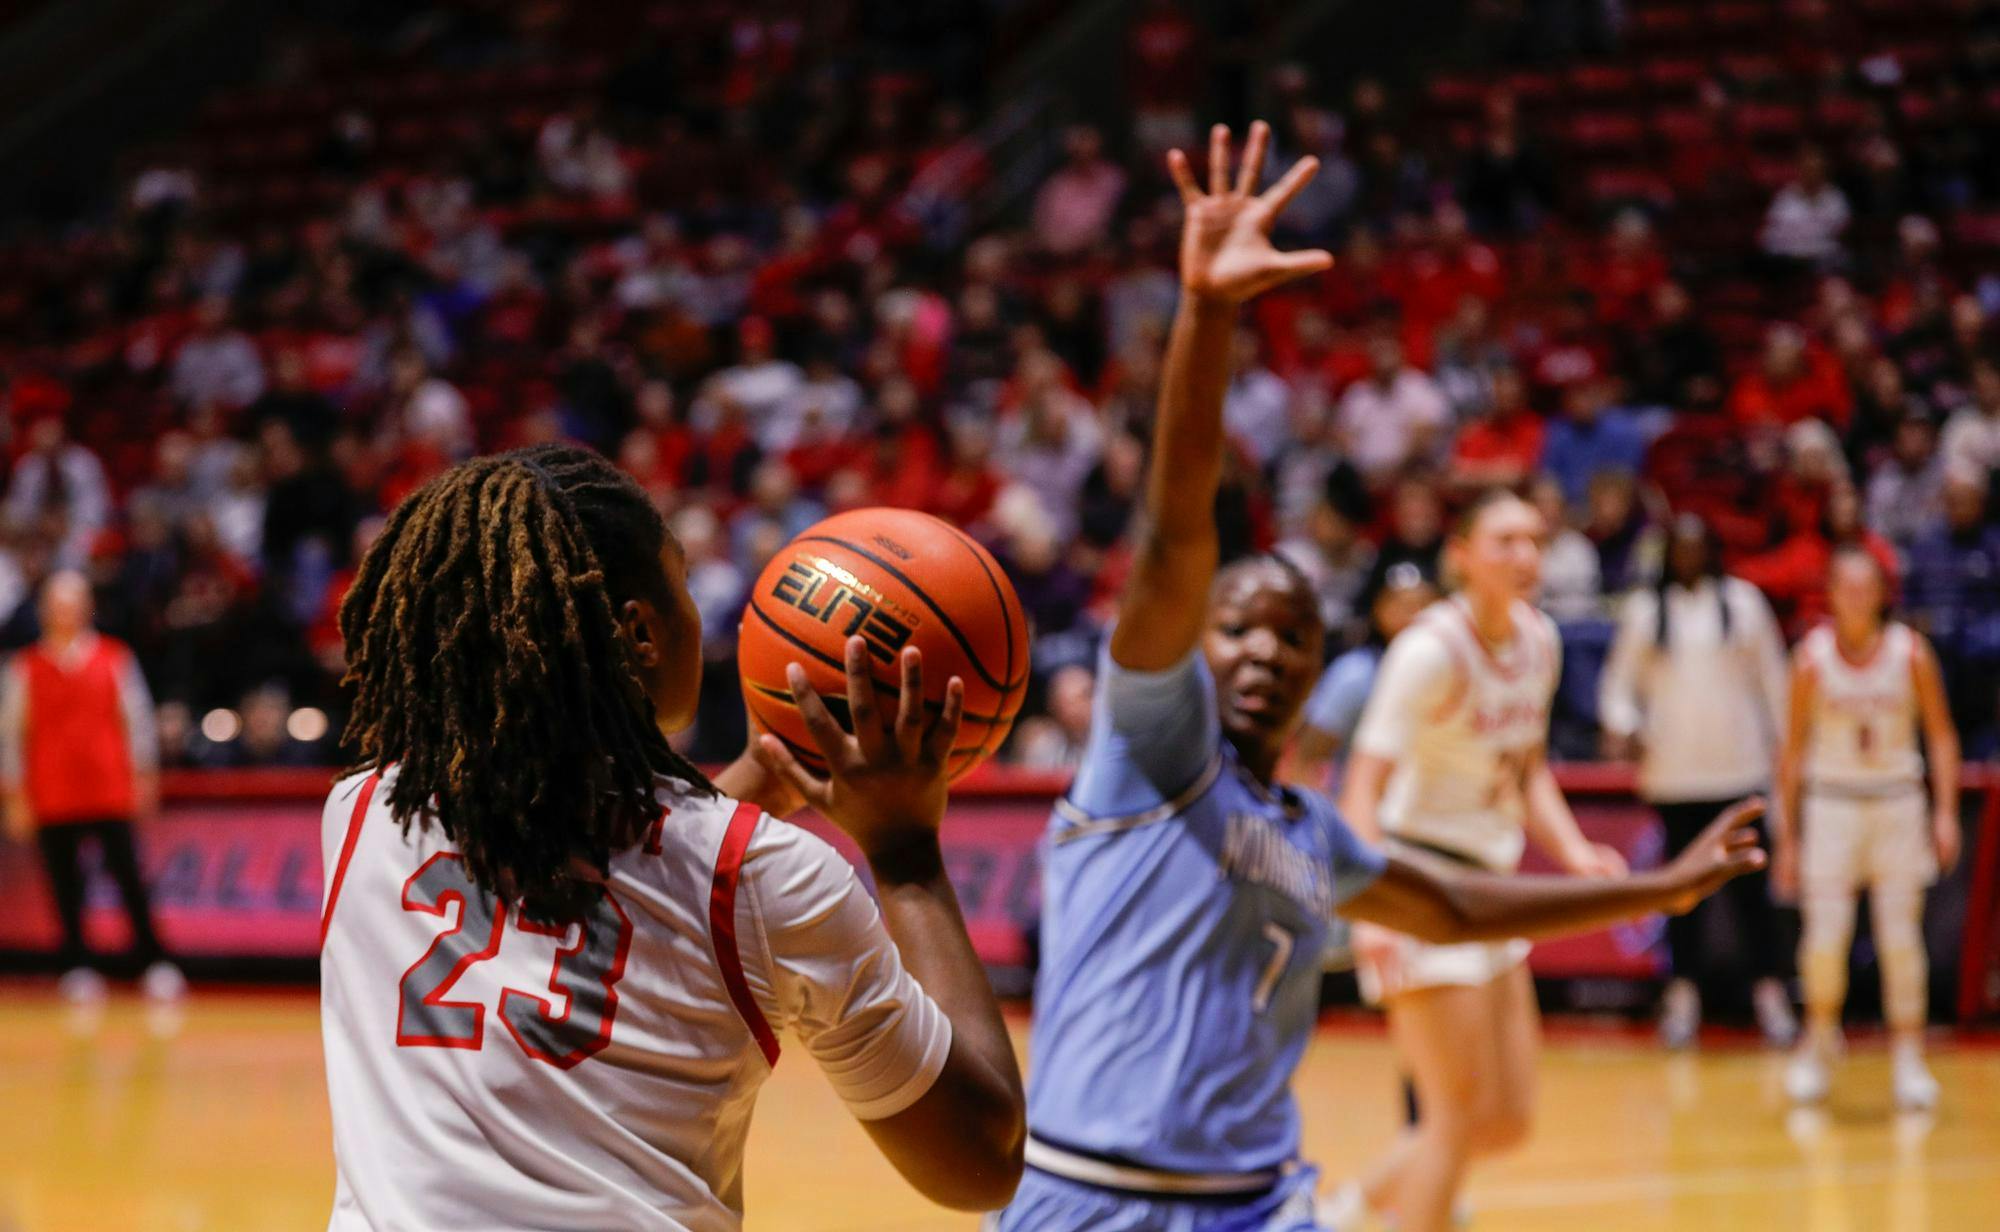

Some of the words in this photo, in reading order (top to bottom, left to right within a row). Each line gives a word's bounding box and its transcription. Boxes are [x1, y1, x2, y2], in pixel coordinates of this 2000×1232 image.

[773, 561, 912, 665] ELITE
[396, 851, 633, 1071] 23
[1253, 921, 1293, 1012] 7
